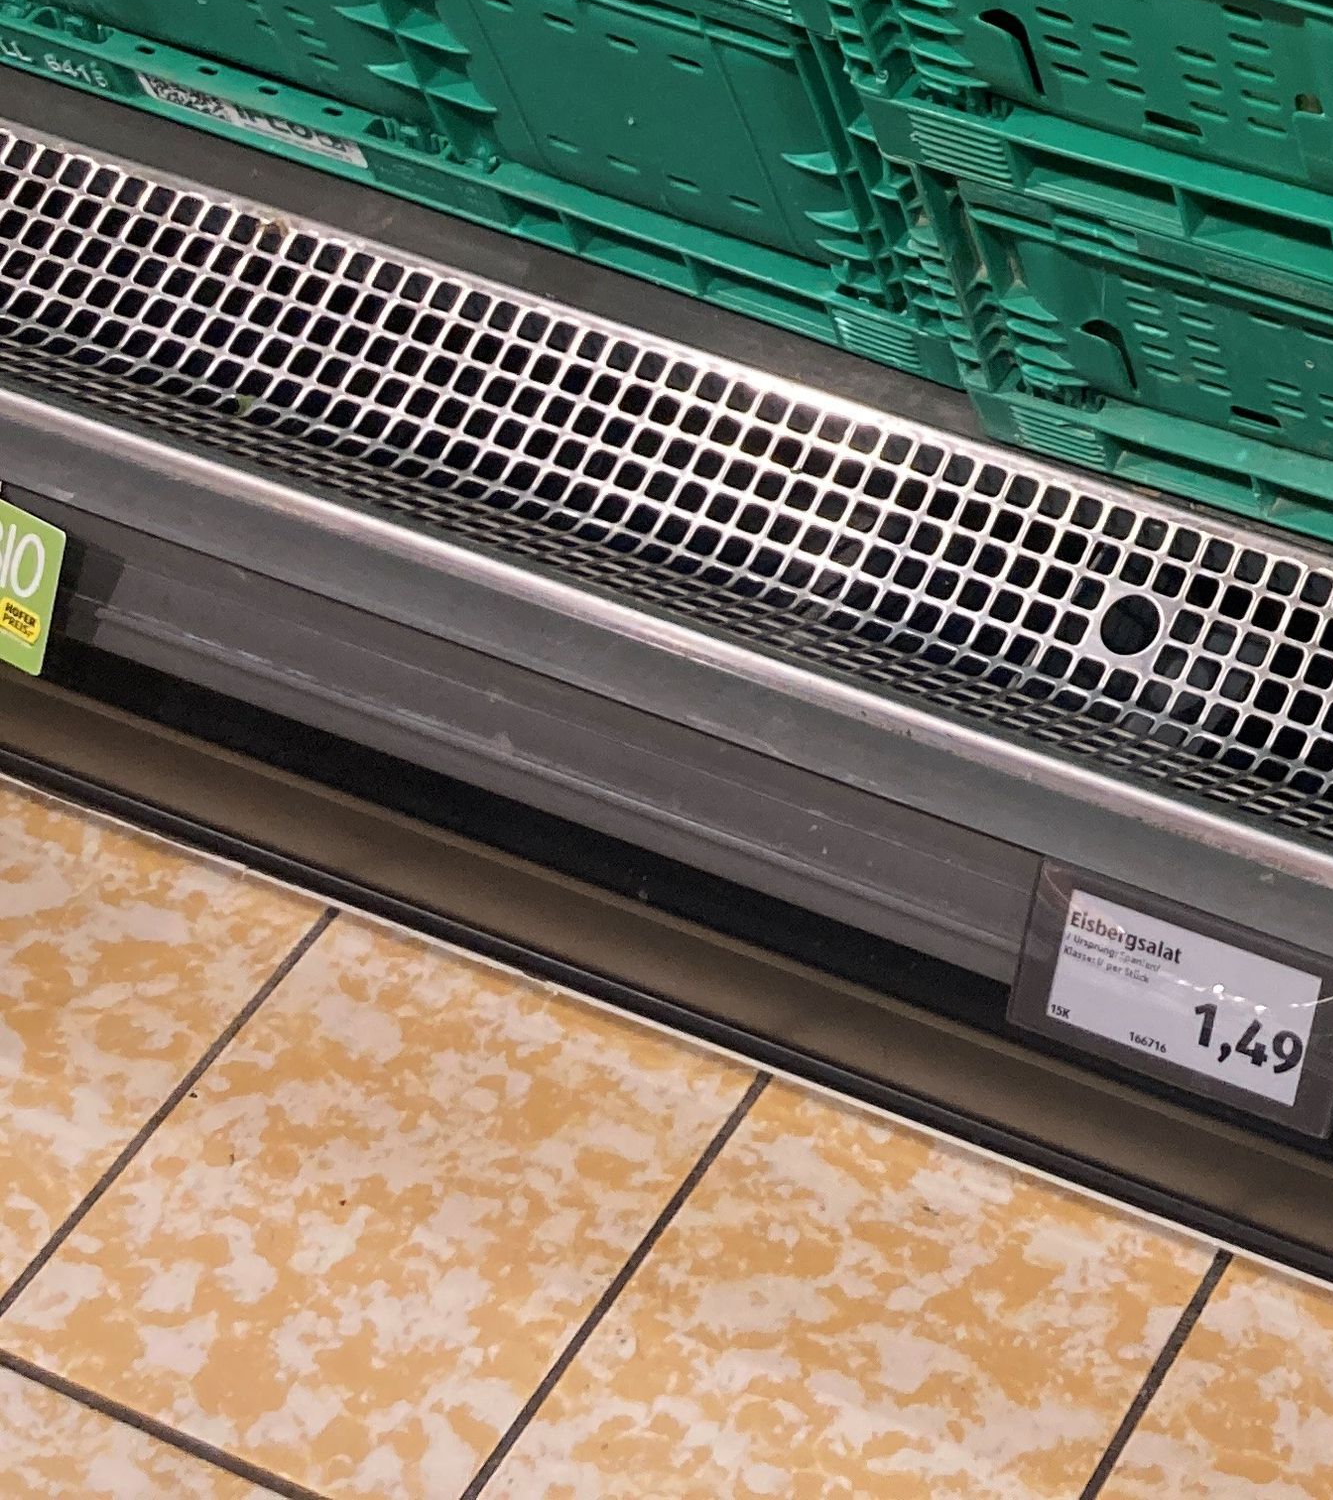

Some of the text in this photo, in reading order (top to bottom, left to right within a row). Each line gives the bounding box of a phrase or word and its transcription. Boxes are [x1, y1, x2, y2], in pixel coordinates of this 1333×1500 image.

[5, 602, 37, 627] HOFER
[1070, 911, 1182, 965] Eisbergsalat
[1050, 1003, 1072, 1020] 15K
[1194, 1002, 1305, 1075] 1,49
